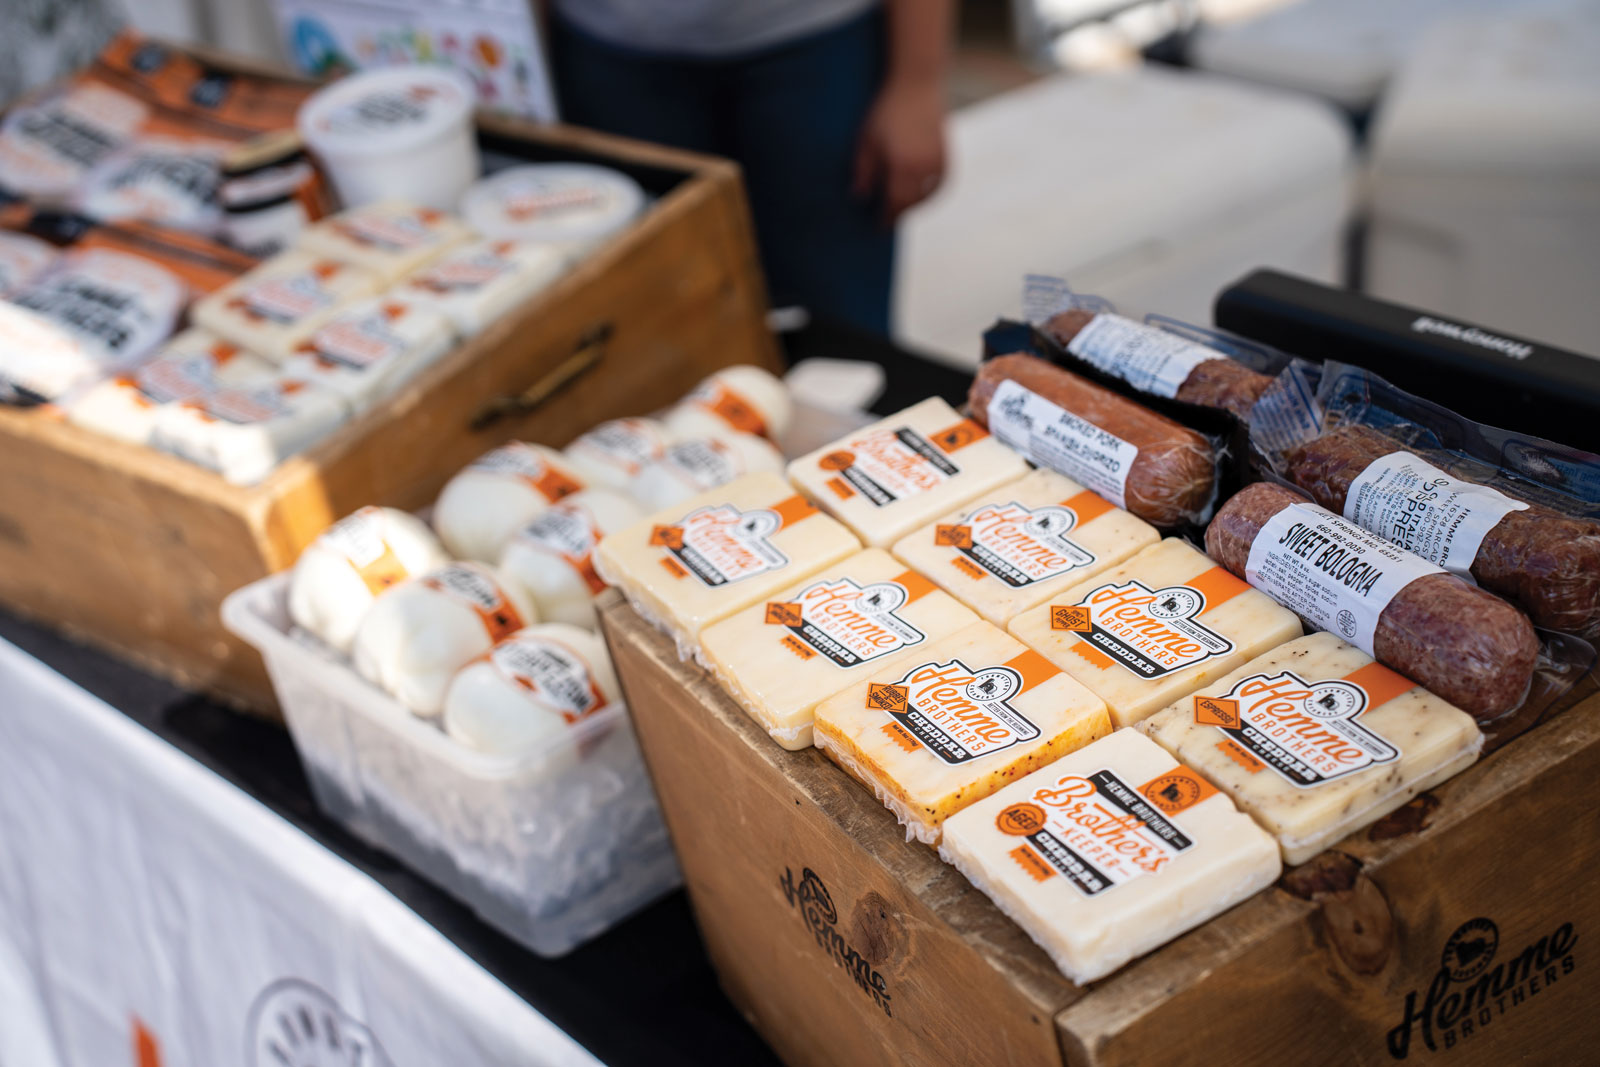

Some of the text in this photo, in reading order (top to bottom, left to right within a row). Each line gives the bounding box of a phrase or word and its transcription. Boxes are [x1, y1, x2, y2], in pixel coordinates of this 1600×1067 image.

[974, 508, 1067, 569] Hemme
[1331, 520, 1365, 540] SPRINGS
[1422, 513, 1440, 554] SPRINGS
[1440, 504, 1460, 527] 16728
[1446, 508, 1471, 544] HEMME
[981, 535, 1045, 576] BROTHERS
[1279, 522, 1383, 597] SWEET BOLOGNA
[1316, 524, 1366, 555] 660-992-0030
[805, 585, 897, 648] Hemme
[810, 612, 875, 656] BROTHERS
[1055, 609, 1086, 628] GHOST
[1091, 588, 1202, 657] Hemme
[803, 625, 856, 664] CHEDDAR
[1092, 633, 1155, 674] CHEDDAR
[1101, 616, 1178, 665] BROTHERS
[882, 685, 906, 704] RUBBED
[911, 667, 1010, 743] Hemme
[1200, 700, 1234, 724] ESPRESSO
[907, 711, 966, 759] CHEDDAR
[914, 726, 945, 751] CHEESE
[917, 698, 986, 751] BROTHERS
[1240, 680, 1363, 764] Hemme
[1251, 713, 1338, 772] BROTHERS
[1241, 727, 1317, 781] CHEDDAR
[1007, 809, 1038, 830] AGED
[1105, 781, 1178, 840] HEMME BROTHERS
[1061, 827, 1121, 867] KEEPER
[780, 866, 892, 1000] Hemme
[1386, 921, 1579, 1060] Hemme
[1443, 955, 1575, 1050] BROTHERS
